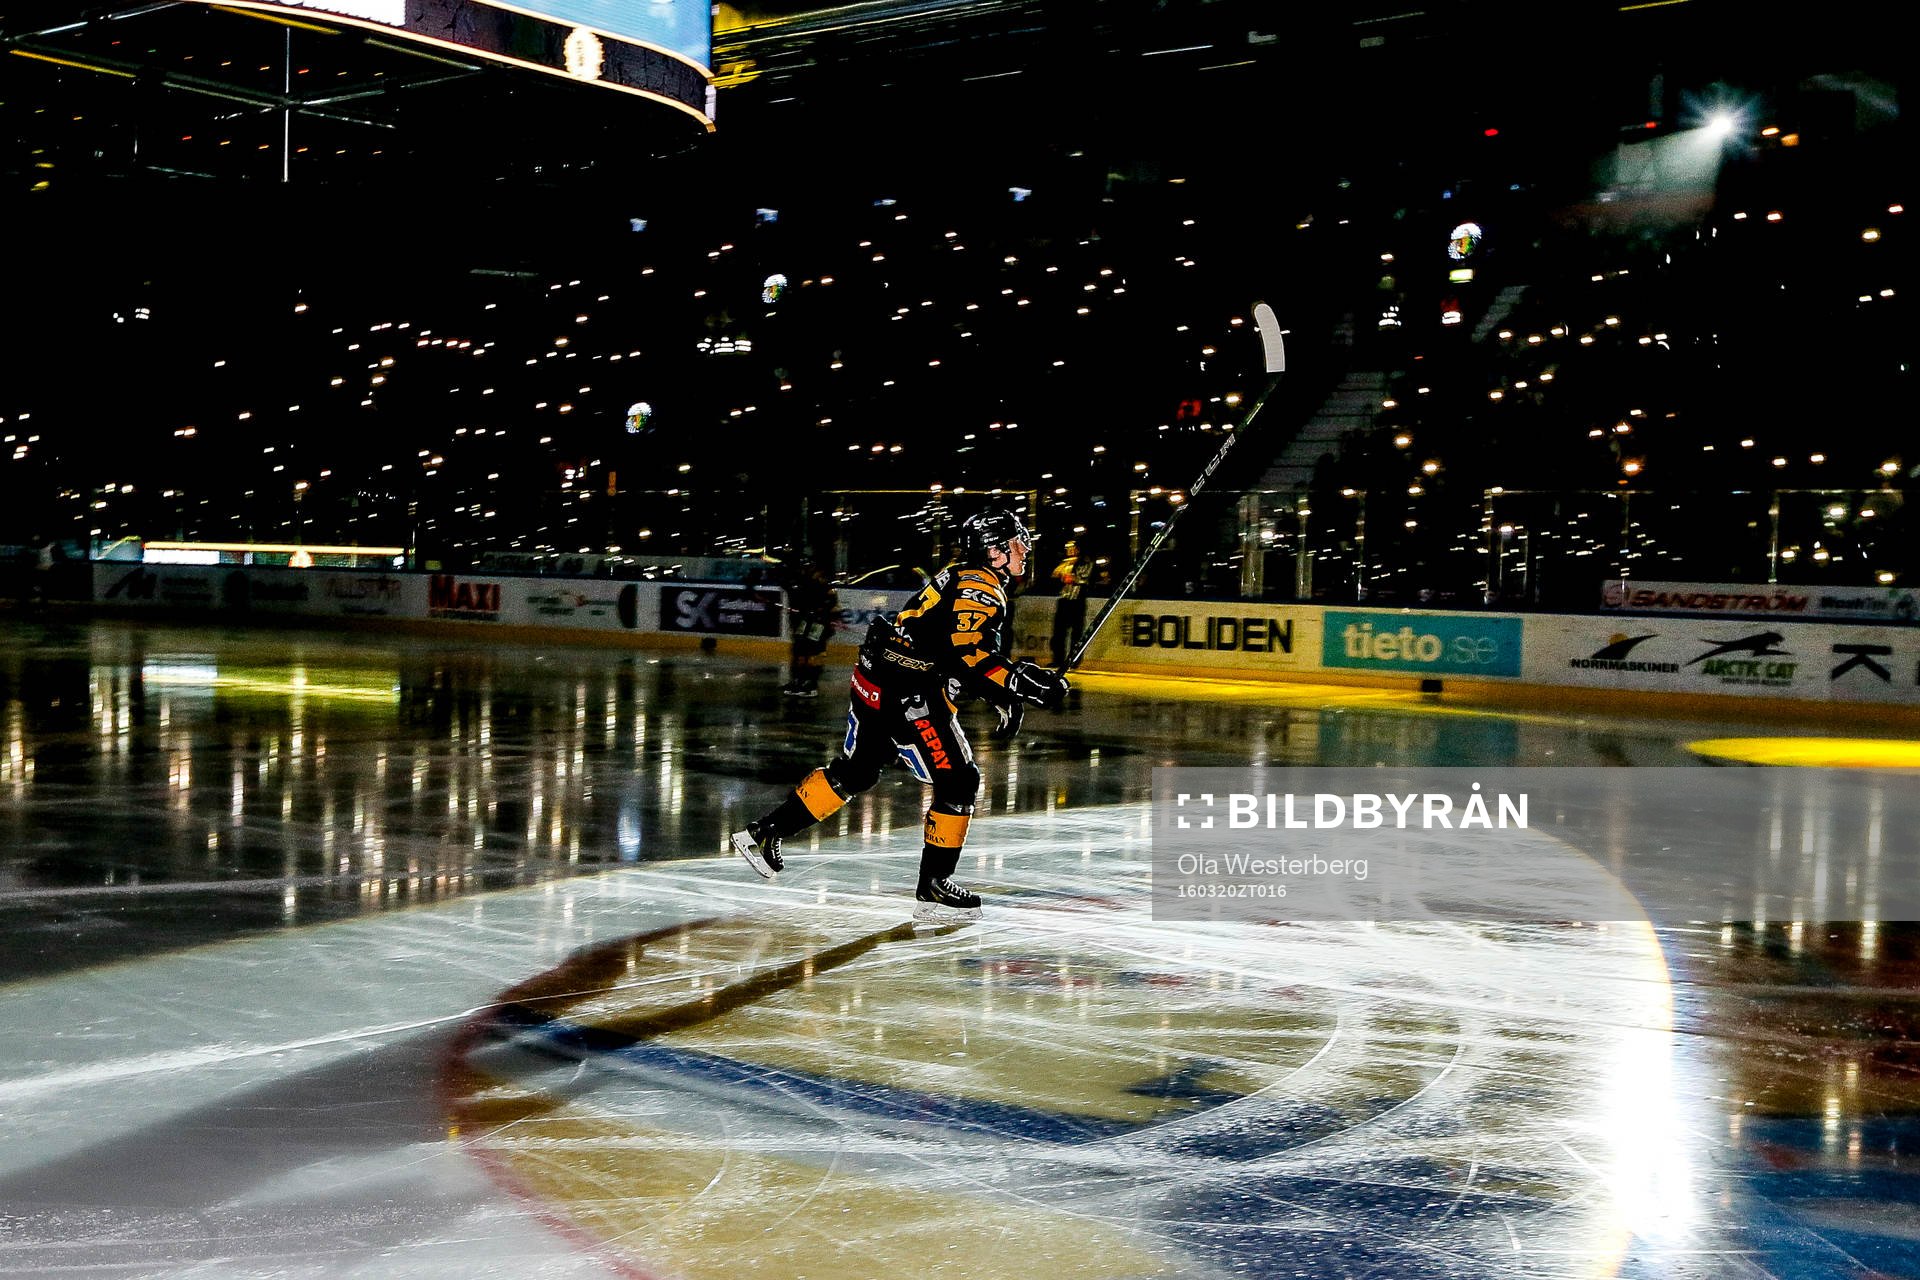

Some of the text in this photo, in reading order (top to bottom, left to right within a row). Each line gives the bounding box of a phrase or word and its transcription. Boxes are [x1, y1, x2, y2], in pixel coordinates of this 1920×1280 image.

[675, 590, 718, 629] SK
[956, 612, 988, 632] 37
[1132, 614, 1293, 652] BOLIDEN
[1571, 658, 1679, 674] NORRMASKINER
[913, 718, 953, 770] REPAY
